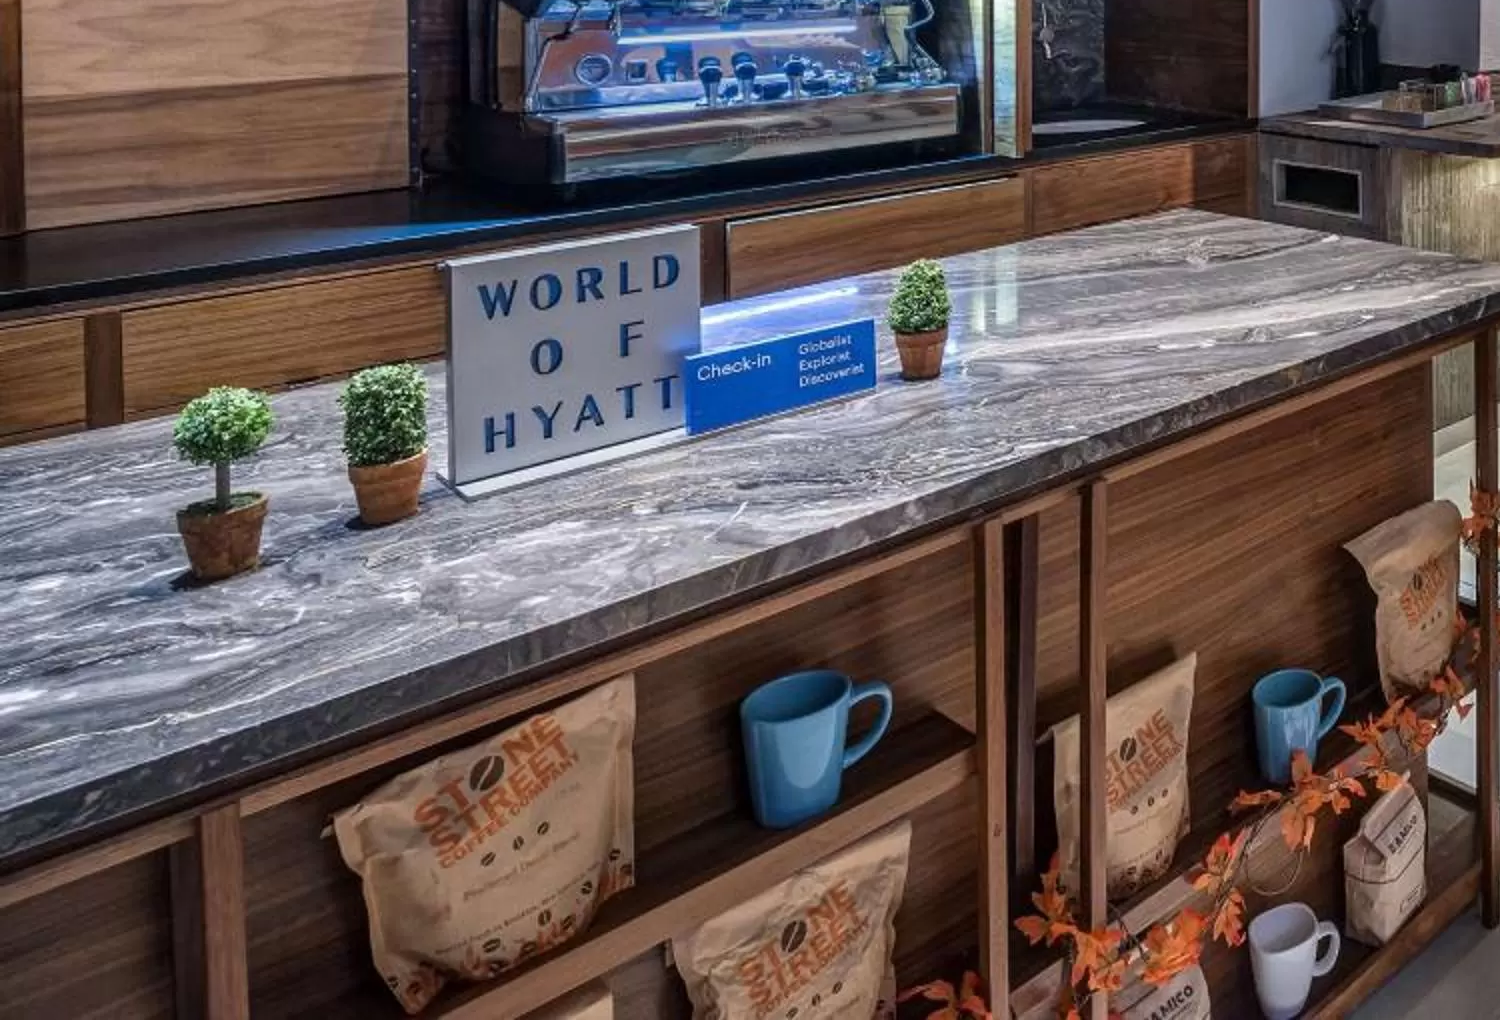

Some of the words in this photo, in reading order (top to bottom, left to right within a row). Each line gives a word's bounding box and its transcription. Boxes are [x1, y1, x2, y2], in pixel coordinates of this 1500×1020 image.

[477, 253, 681, 321] WORLD
[531, 320, 646, 376] OF
[697, 352, 772, 382] Check-in
[799, 334, 852, 355] Globalist
[799, 351, 851, 373] Explorist
[483, 375, 681, 454] HYATT
[427, 731, 574, 850] STREET
